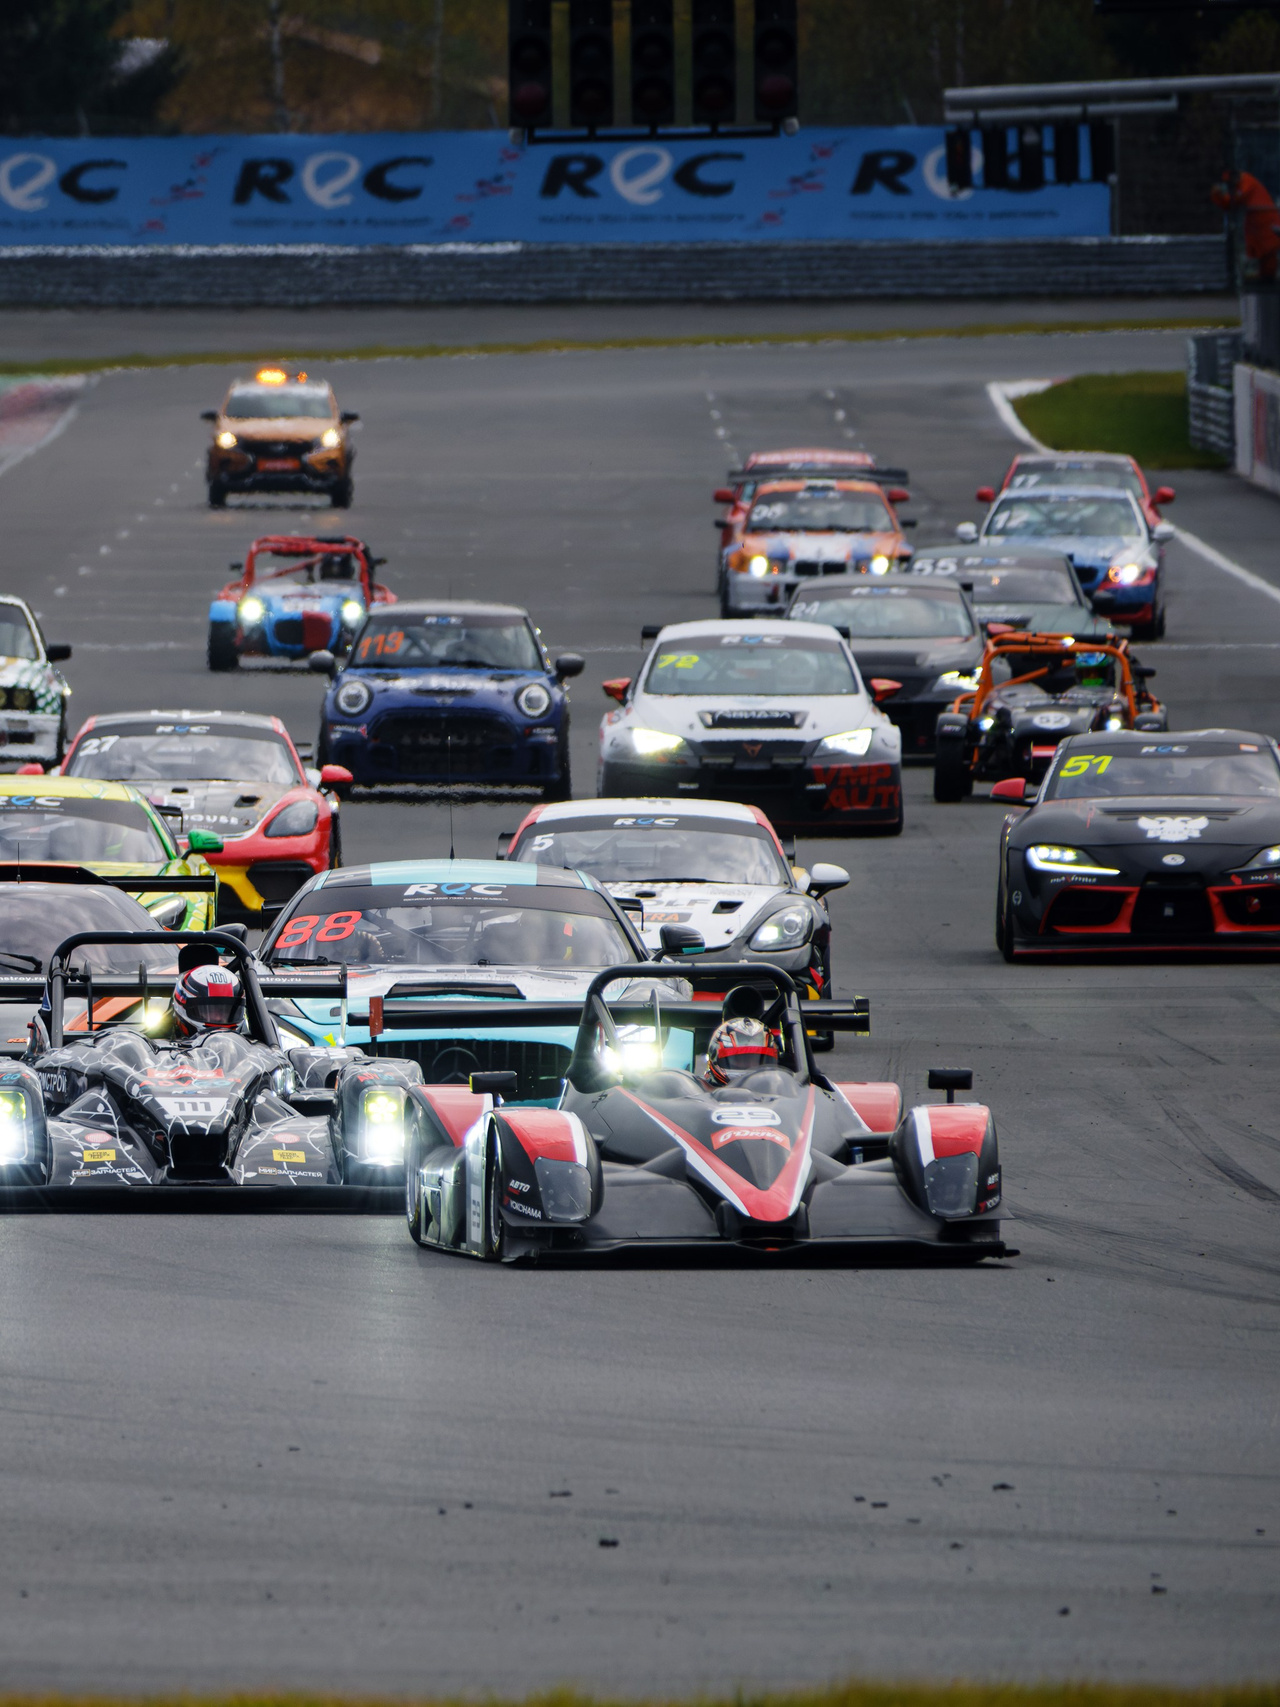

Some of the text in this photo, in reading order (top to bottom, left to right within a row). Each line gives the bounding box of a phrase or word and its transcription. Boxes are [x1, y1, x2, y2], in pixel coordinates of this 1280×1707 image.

[912, 557, 958, 576] 55
[790, 602, 819, 618] 24
[658, 655, 699, 669] 72
[79, 735, 120, 757] 27
[811, 763, 892, 785] VMP
[1060, 755, 1113, 777] 51
[531, 833, 555, 851] 5
[274, 911, 362, 949] 88
[174, 1101, 212, 1112] 111
[509, 1179, 531, 1193] АВТО
[510, 1199, 542, 1220] YOKOHAMA
